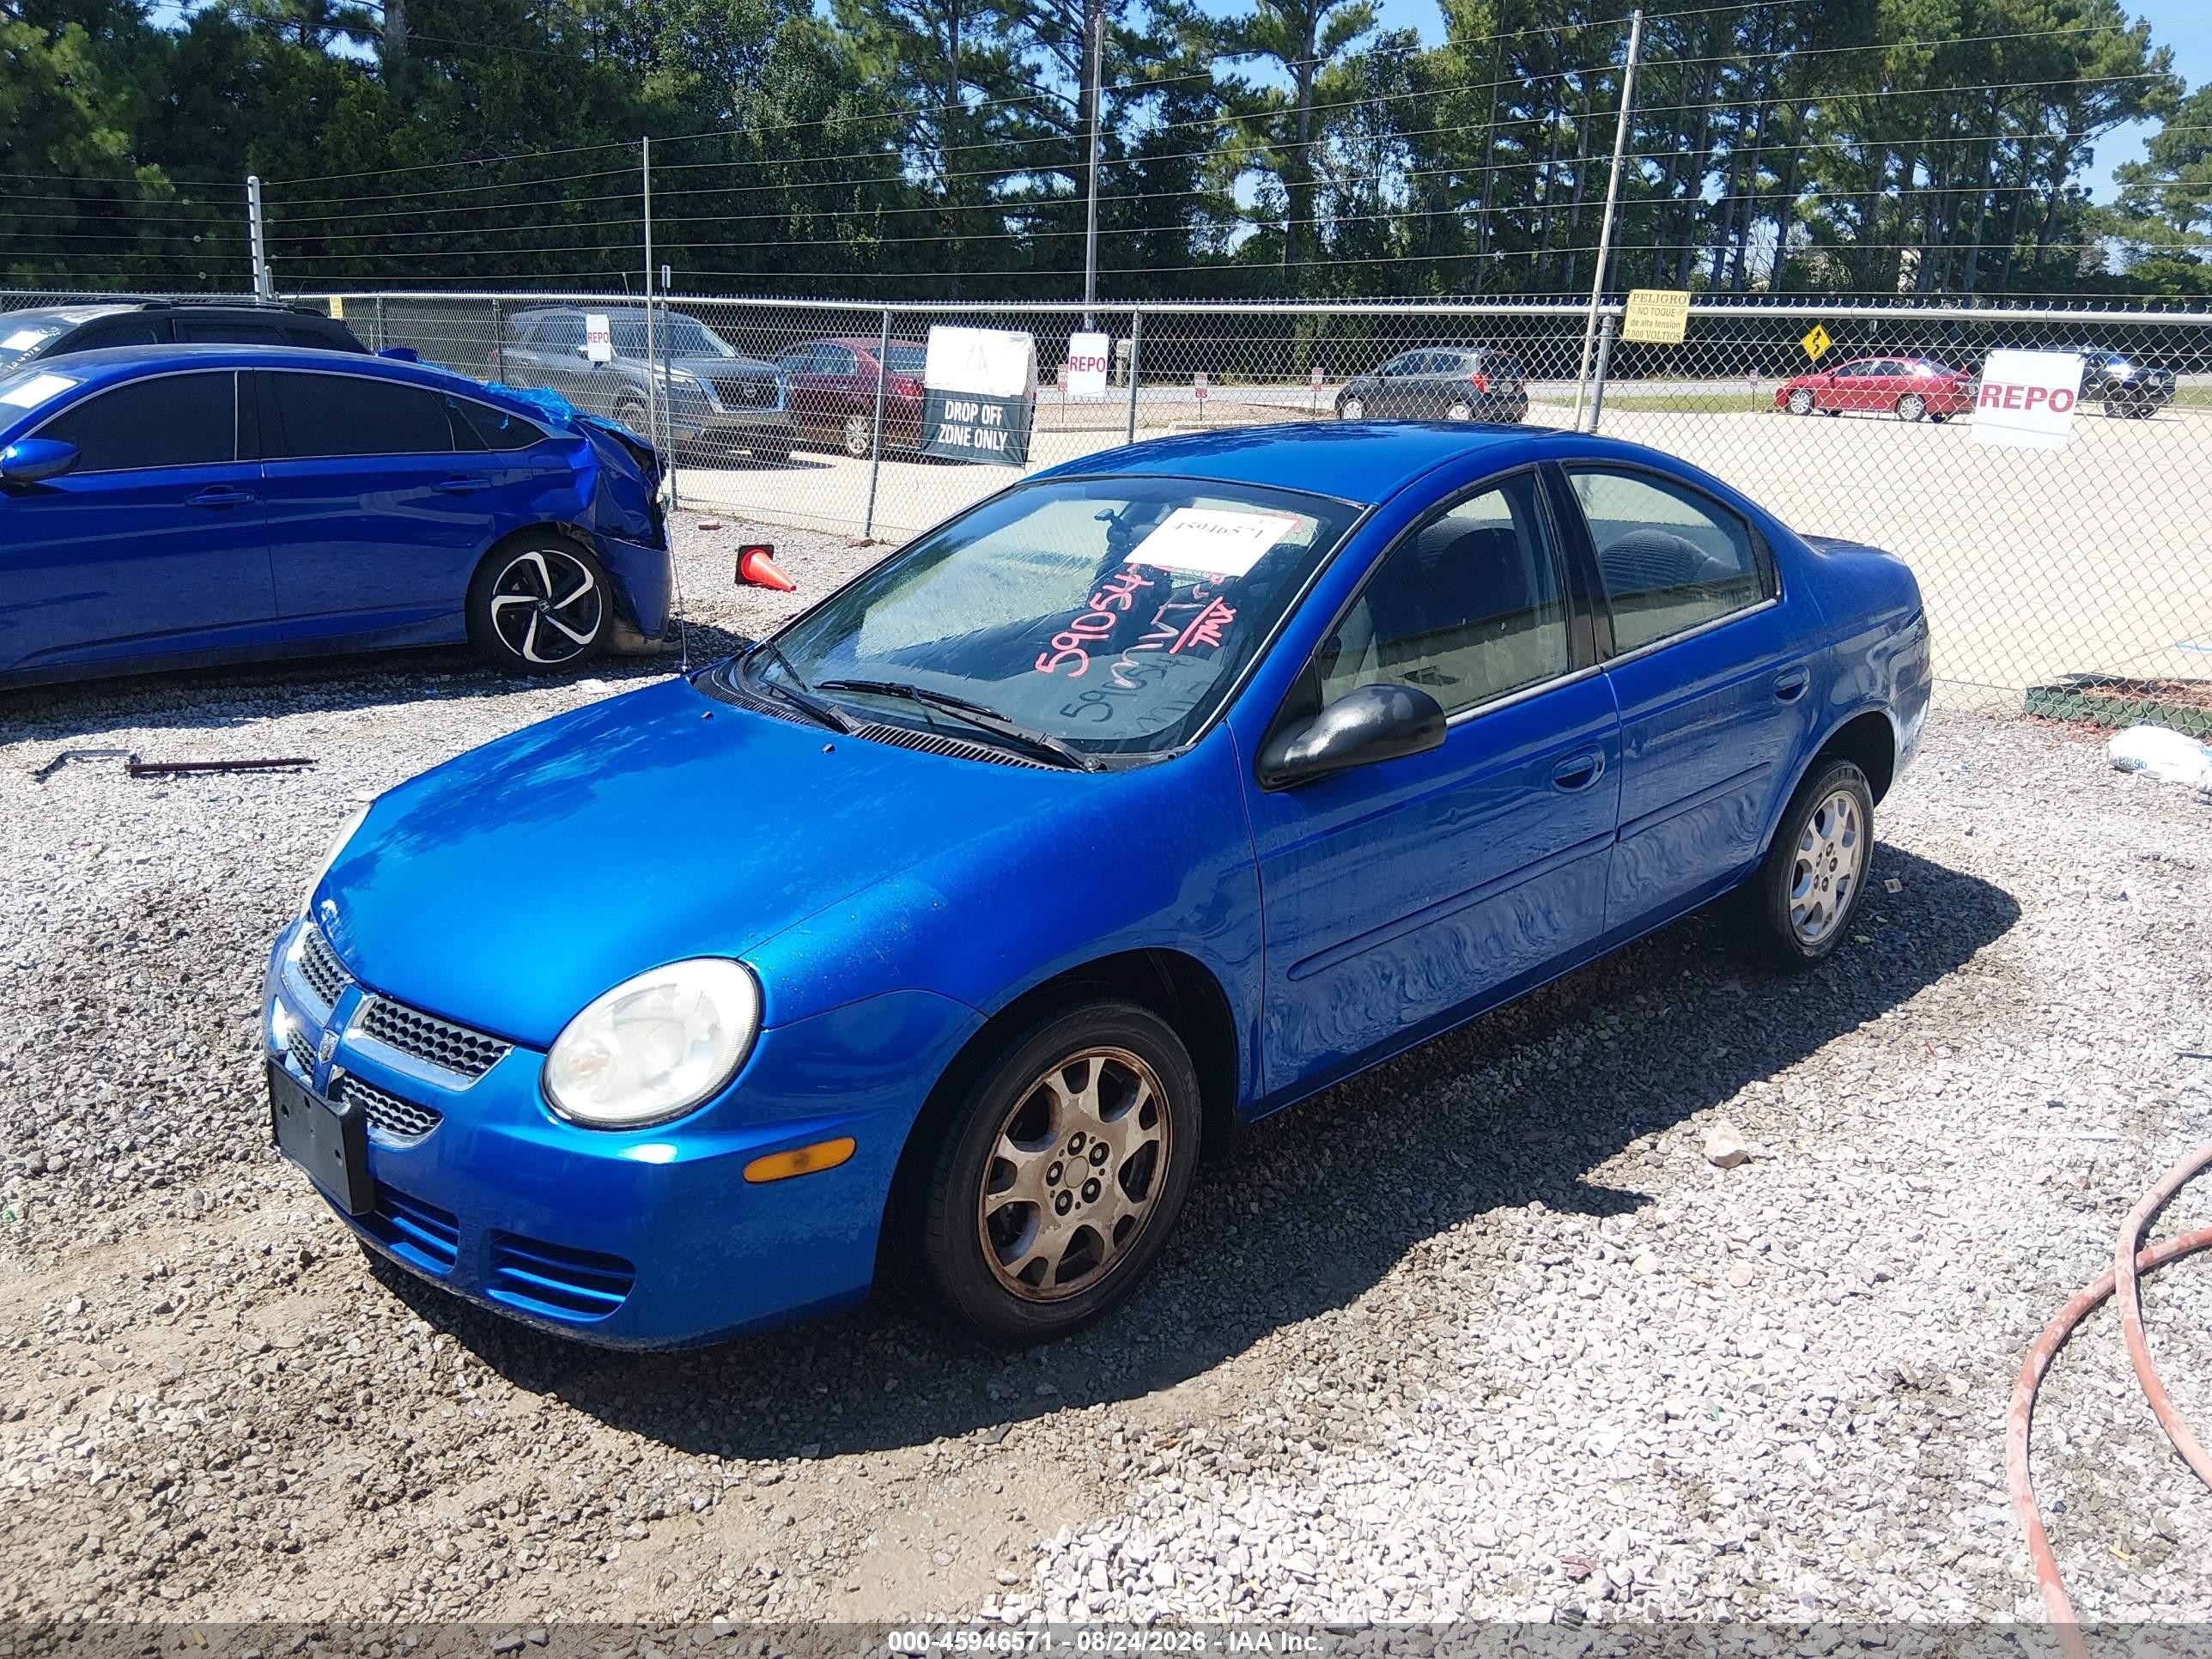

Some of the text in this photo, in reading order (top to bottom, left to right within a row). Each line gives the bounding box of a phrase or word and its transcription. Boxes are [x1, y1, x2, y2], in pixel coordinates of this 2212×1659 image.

[1632, 293, 1687, 305] PELIGRO
[1638, 307, 1676, 317] NO TOQUE
[1631, 319, 1681, 330] de alta tension
[587, 331, 610, 343] REPO
[1645, 331, 1681, 341] VOLTIOS
[1069, 356, 1106, 373] REPO
[1979, 384, 2075, 413] REPO
[945, 400, 1003, 427] DROP OFF
[937, 424, 1009, 452] ZONE ONLY
